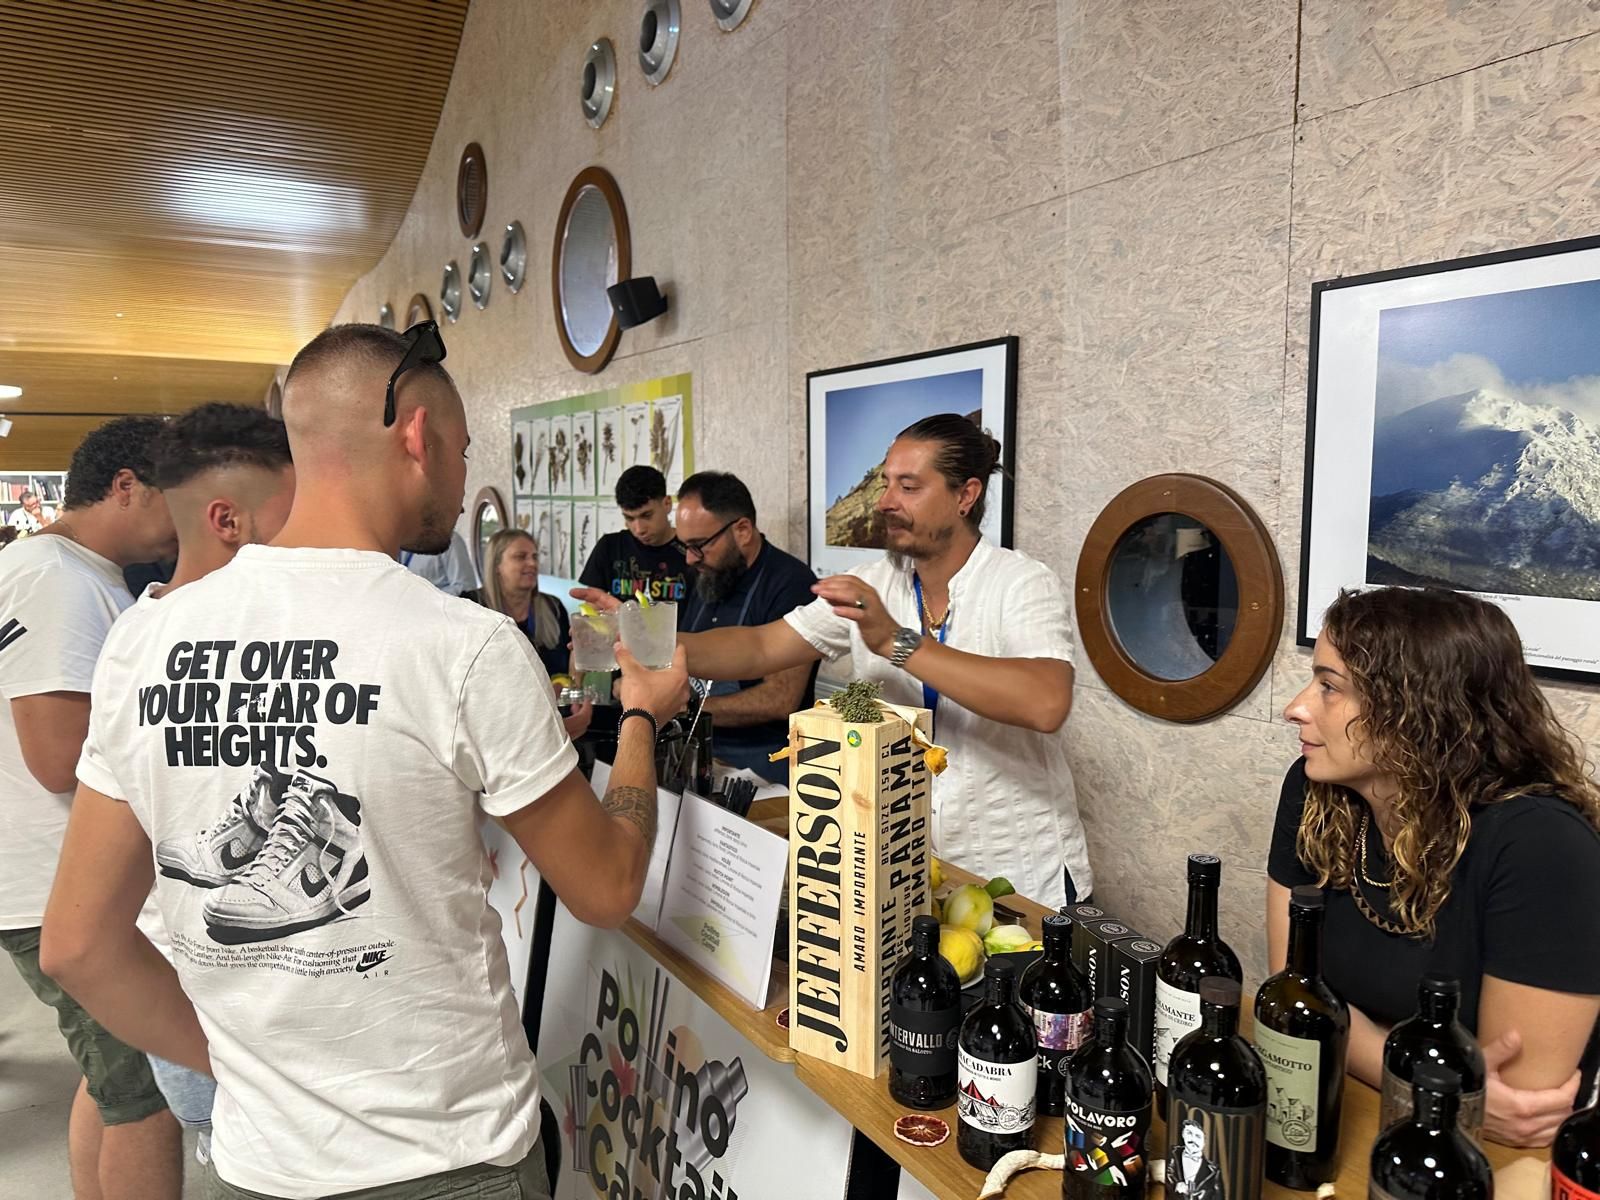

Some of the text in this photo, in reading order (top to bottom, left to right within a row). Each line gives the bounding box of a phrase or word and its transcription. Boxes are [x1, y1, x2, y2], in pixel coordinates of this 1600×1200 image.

[166, 639, 339, 681] GET OVER
[138, 681, 381, 727] YOUR FEAR OF
[164, 725, 328, 768] HEIGHTS.
[881, 742, 890, 758] CL
[881, 803, 889, 835] SIZE
[890, 735, 911, 890] PANAMA
[881, 842, 889, 865] BIG
[911, 816, 925, 909] AMARO
[796, 730, 848, 1053] JEFFERSON
[853, 831, 867, 973] AMARO IMPORTANTE
[230, 952, 265, 962] full-length
[302, 957, 341, 967] cushioning
[342, 954, 357, 963] that
[248, 945, 279, 953] basketball
[306, 944, 367, 959] center-of-pressure
[368, 939, 396, 950] outsole.
[361, 950, 387, 964] NIKE
[247, 960, 258, 968] the
[326, 965, 355, 975] anxiety.
[890, 1021, 943, 1048] NTERVALLO
[1065, 1091, 1137, 1128] POLAVORO
